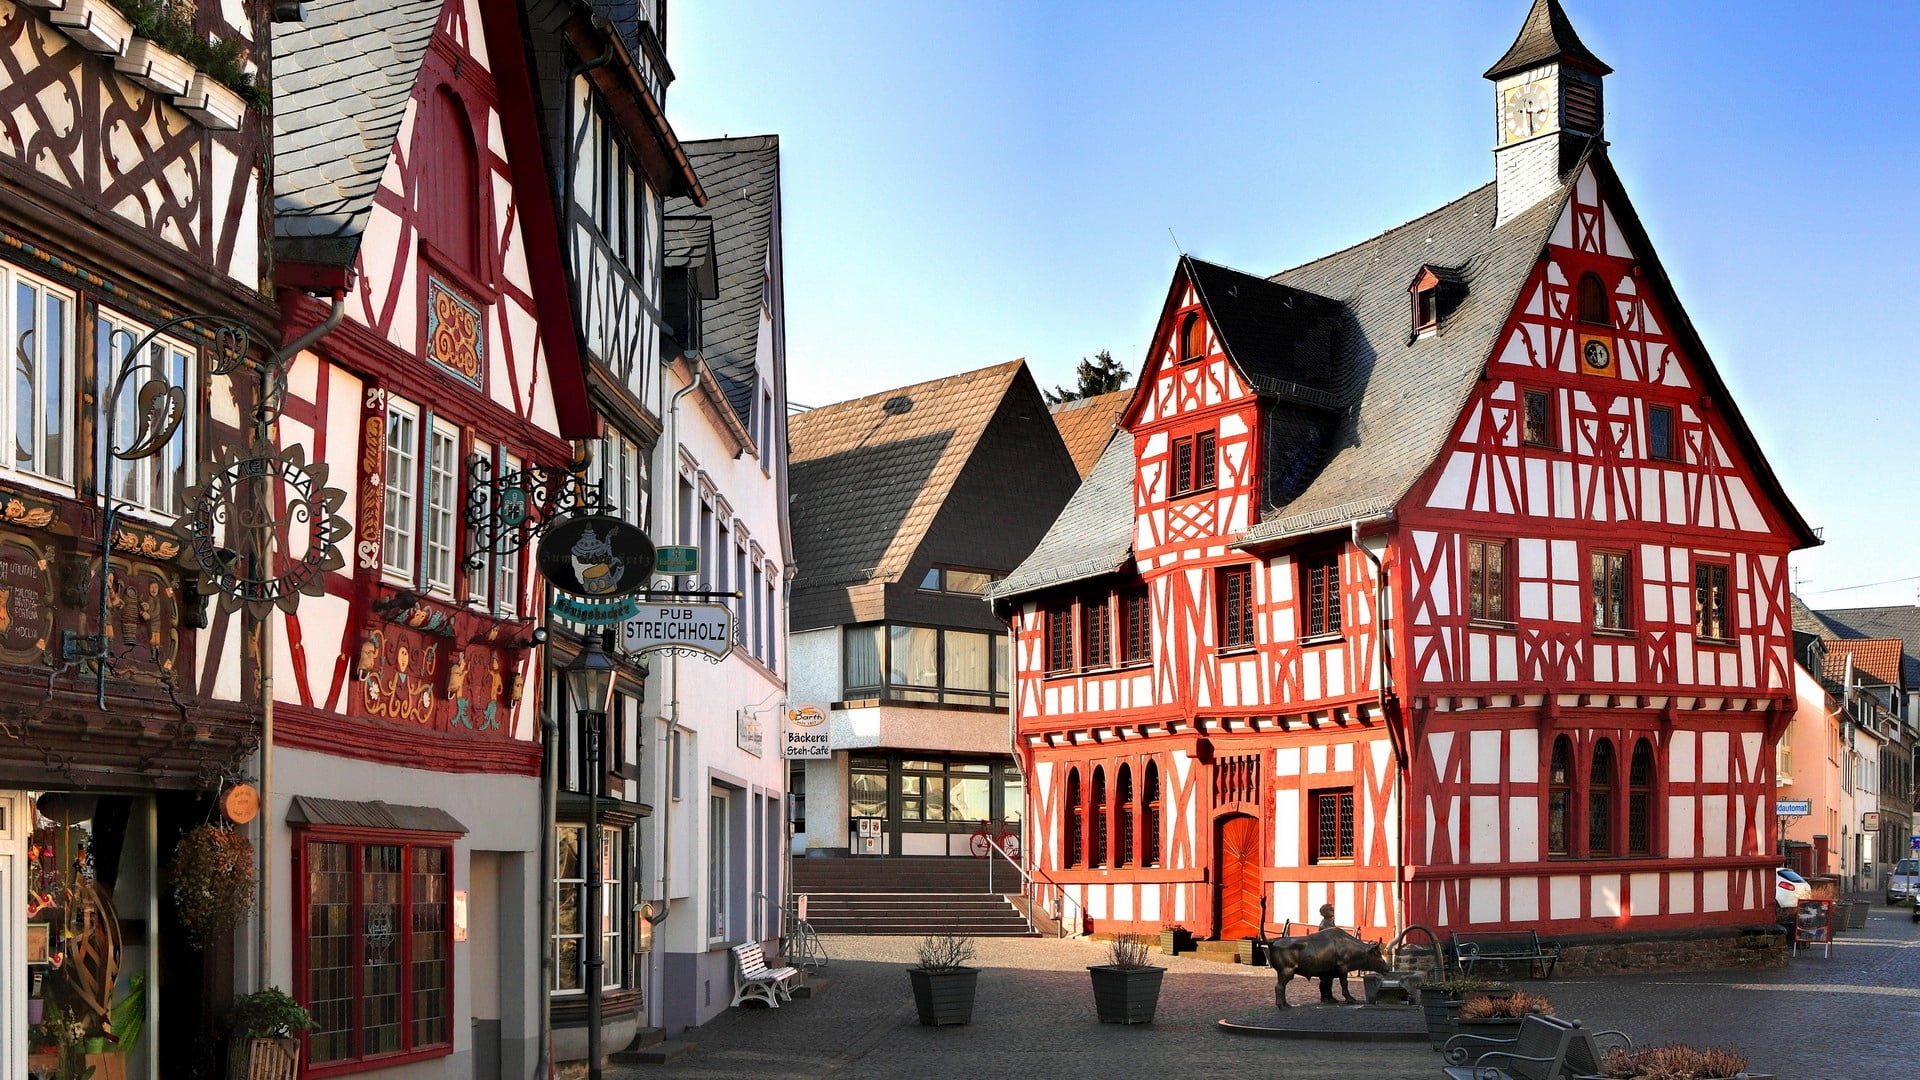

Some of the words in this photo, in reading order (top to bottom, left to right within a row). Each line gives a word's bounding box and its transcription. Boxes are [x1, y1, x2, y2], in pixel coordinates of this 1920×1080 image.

[660, 609, 693, 620] PUB
[626, 622, 725, 641] STREICHHOLZ
[795, 710, 823, 721] Barth
[788, 732, 828, 743] Bäckerei
[787, 746, 829, 755] Steh-Café
